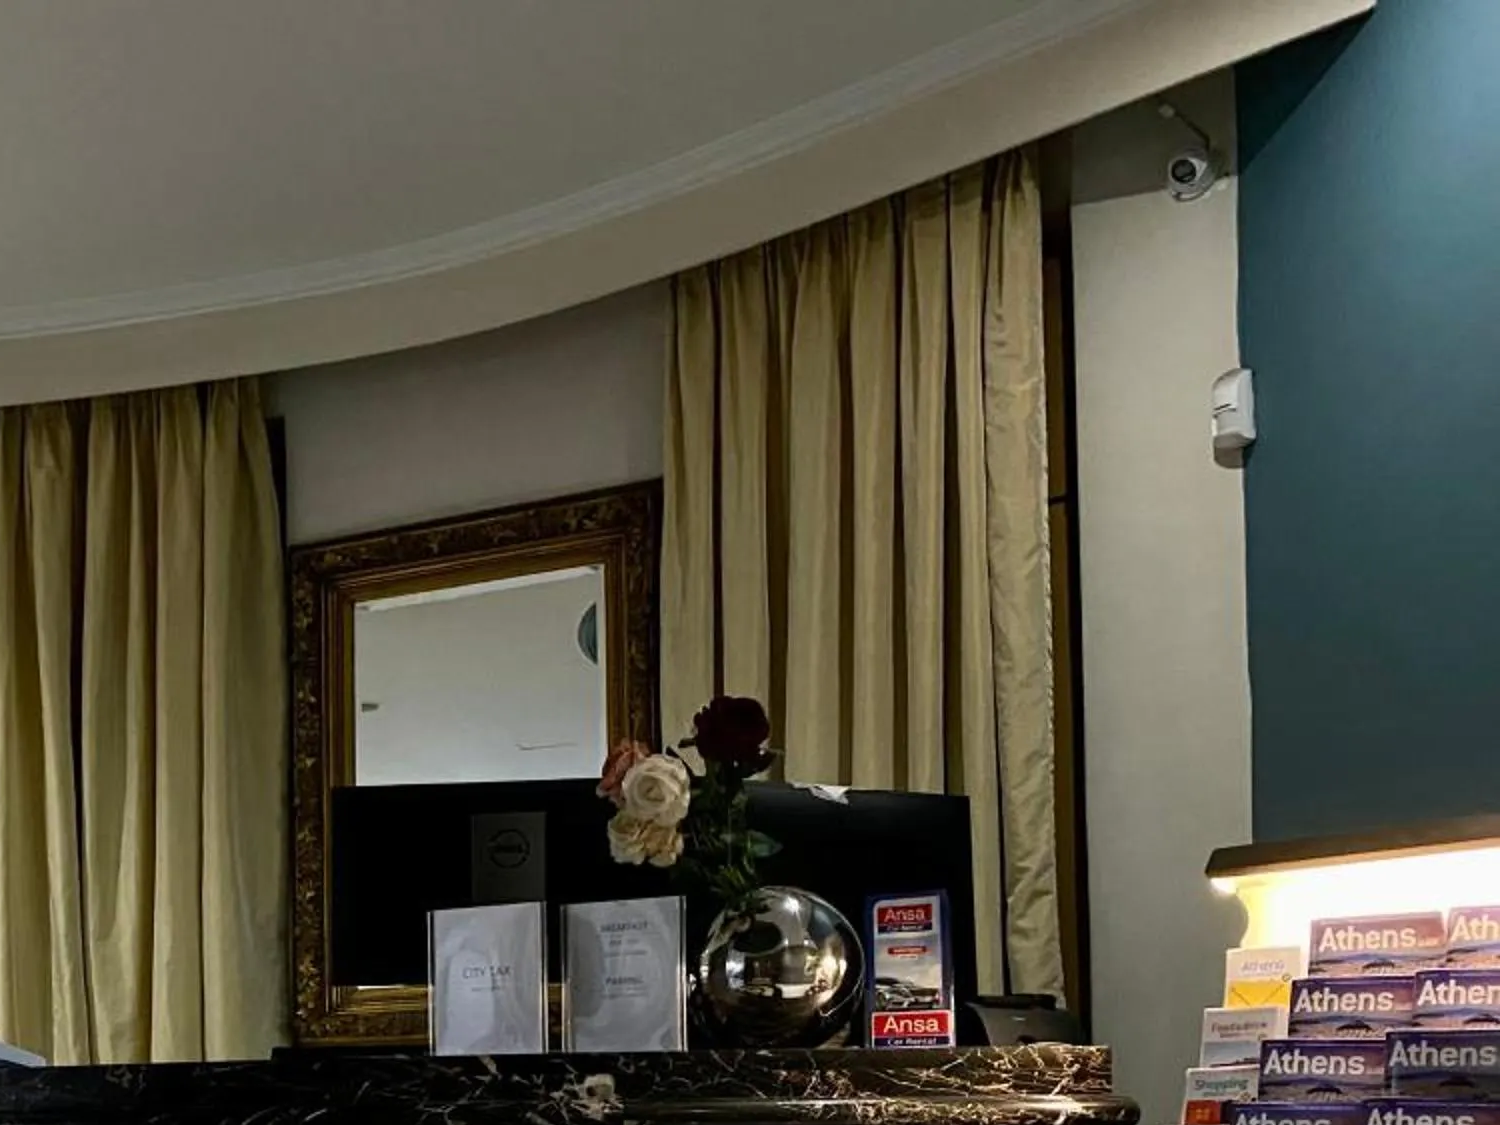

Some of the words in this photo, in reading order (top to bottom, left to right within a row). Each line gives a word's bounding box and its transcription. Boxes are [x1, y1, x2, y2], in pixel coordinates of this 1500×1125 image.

[884, 908, 925, 922] Ansa
[1319, 926, 1417, 953] Athens
[1294, 987, 1395, 1013] Athens
[883, 1015, 939, 1034] Ansa
[1264, 1048, 1365, 1076] Athens
[1388, 1040, 1497, 1067] Athens
